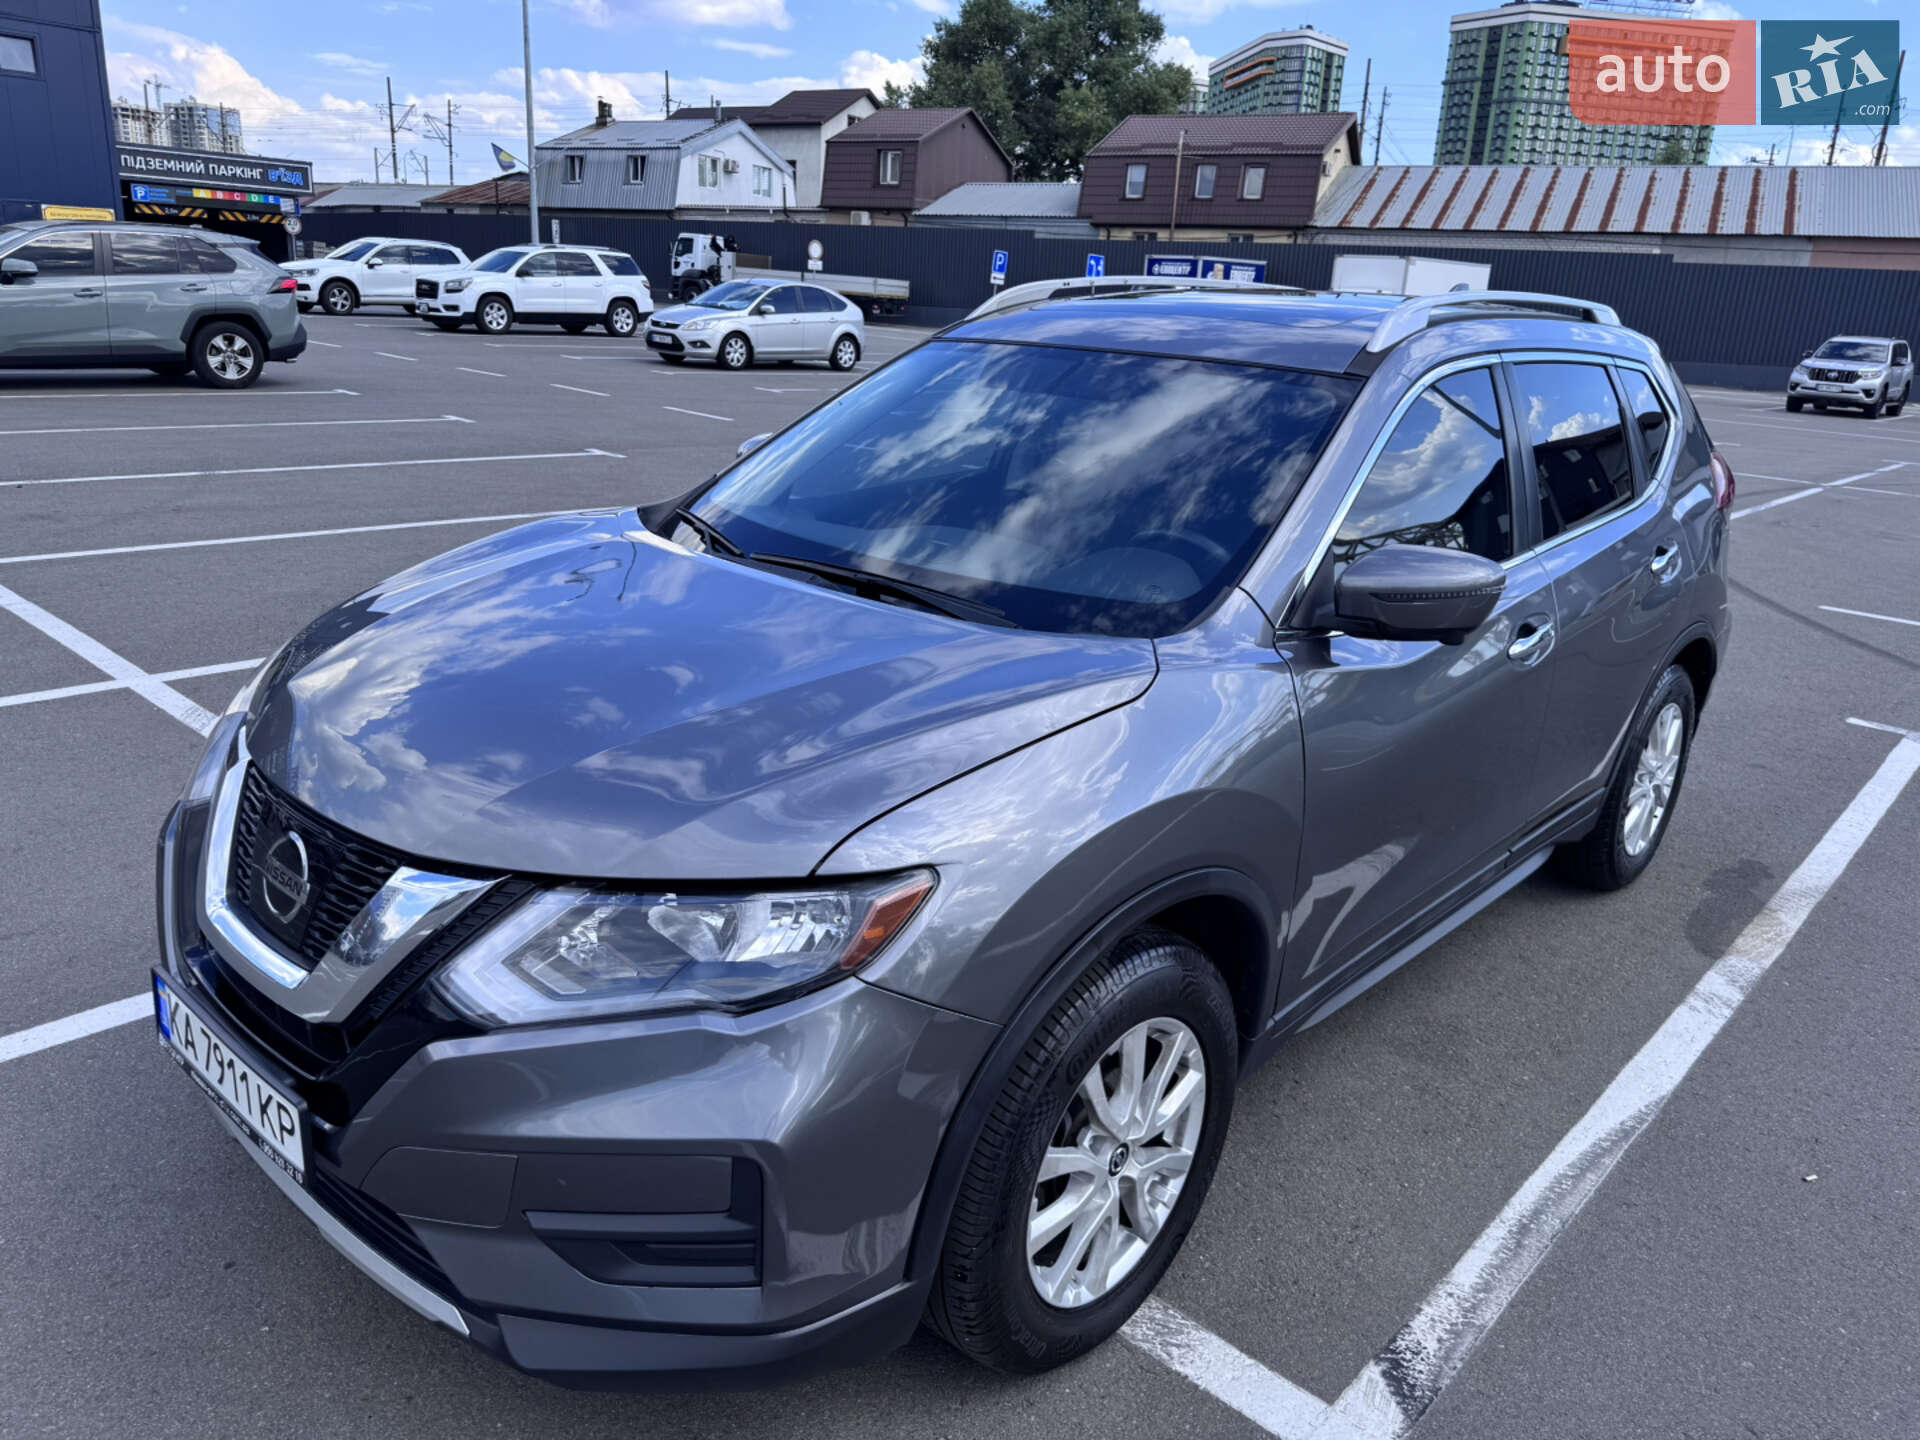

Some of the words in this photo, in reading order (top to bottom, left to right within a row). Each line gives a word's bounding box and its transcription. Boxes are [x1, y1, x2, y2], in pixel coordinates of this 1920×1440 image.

[120, 154, 205, 175] ПІДЗЕМНИЙ
[208, 163, 263, 180] ПАРКІНГ
[216, 191, 224, 199] B
[234, 192, 241, 201] C
[251, 194, 258, 202] D
[268, 195, 275, 203] E
[995, 253, 1005, 270] P
[168, 992, 199, 1062] KA
[200, 1027, 252, 1115] 7911
[256, 1083, 296, 1145] KP
